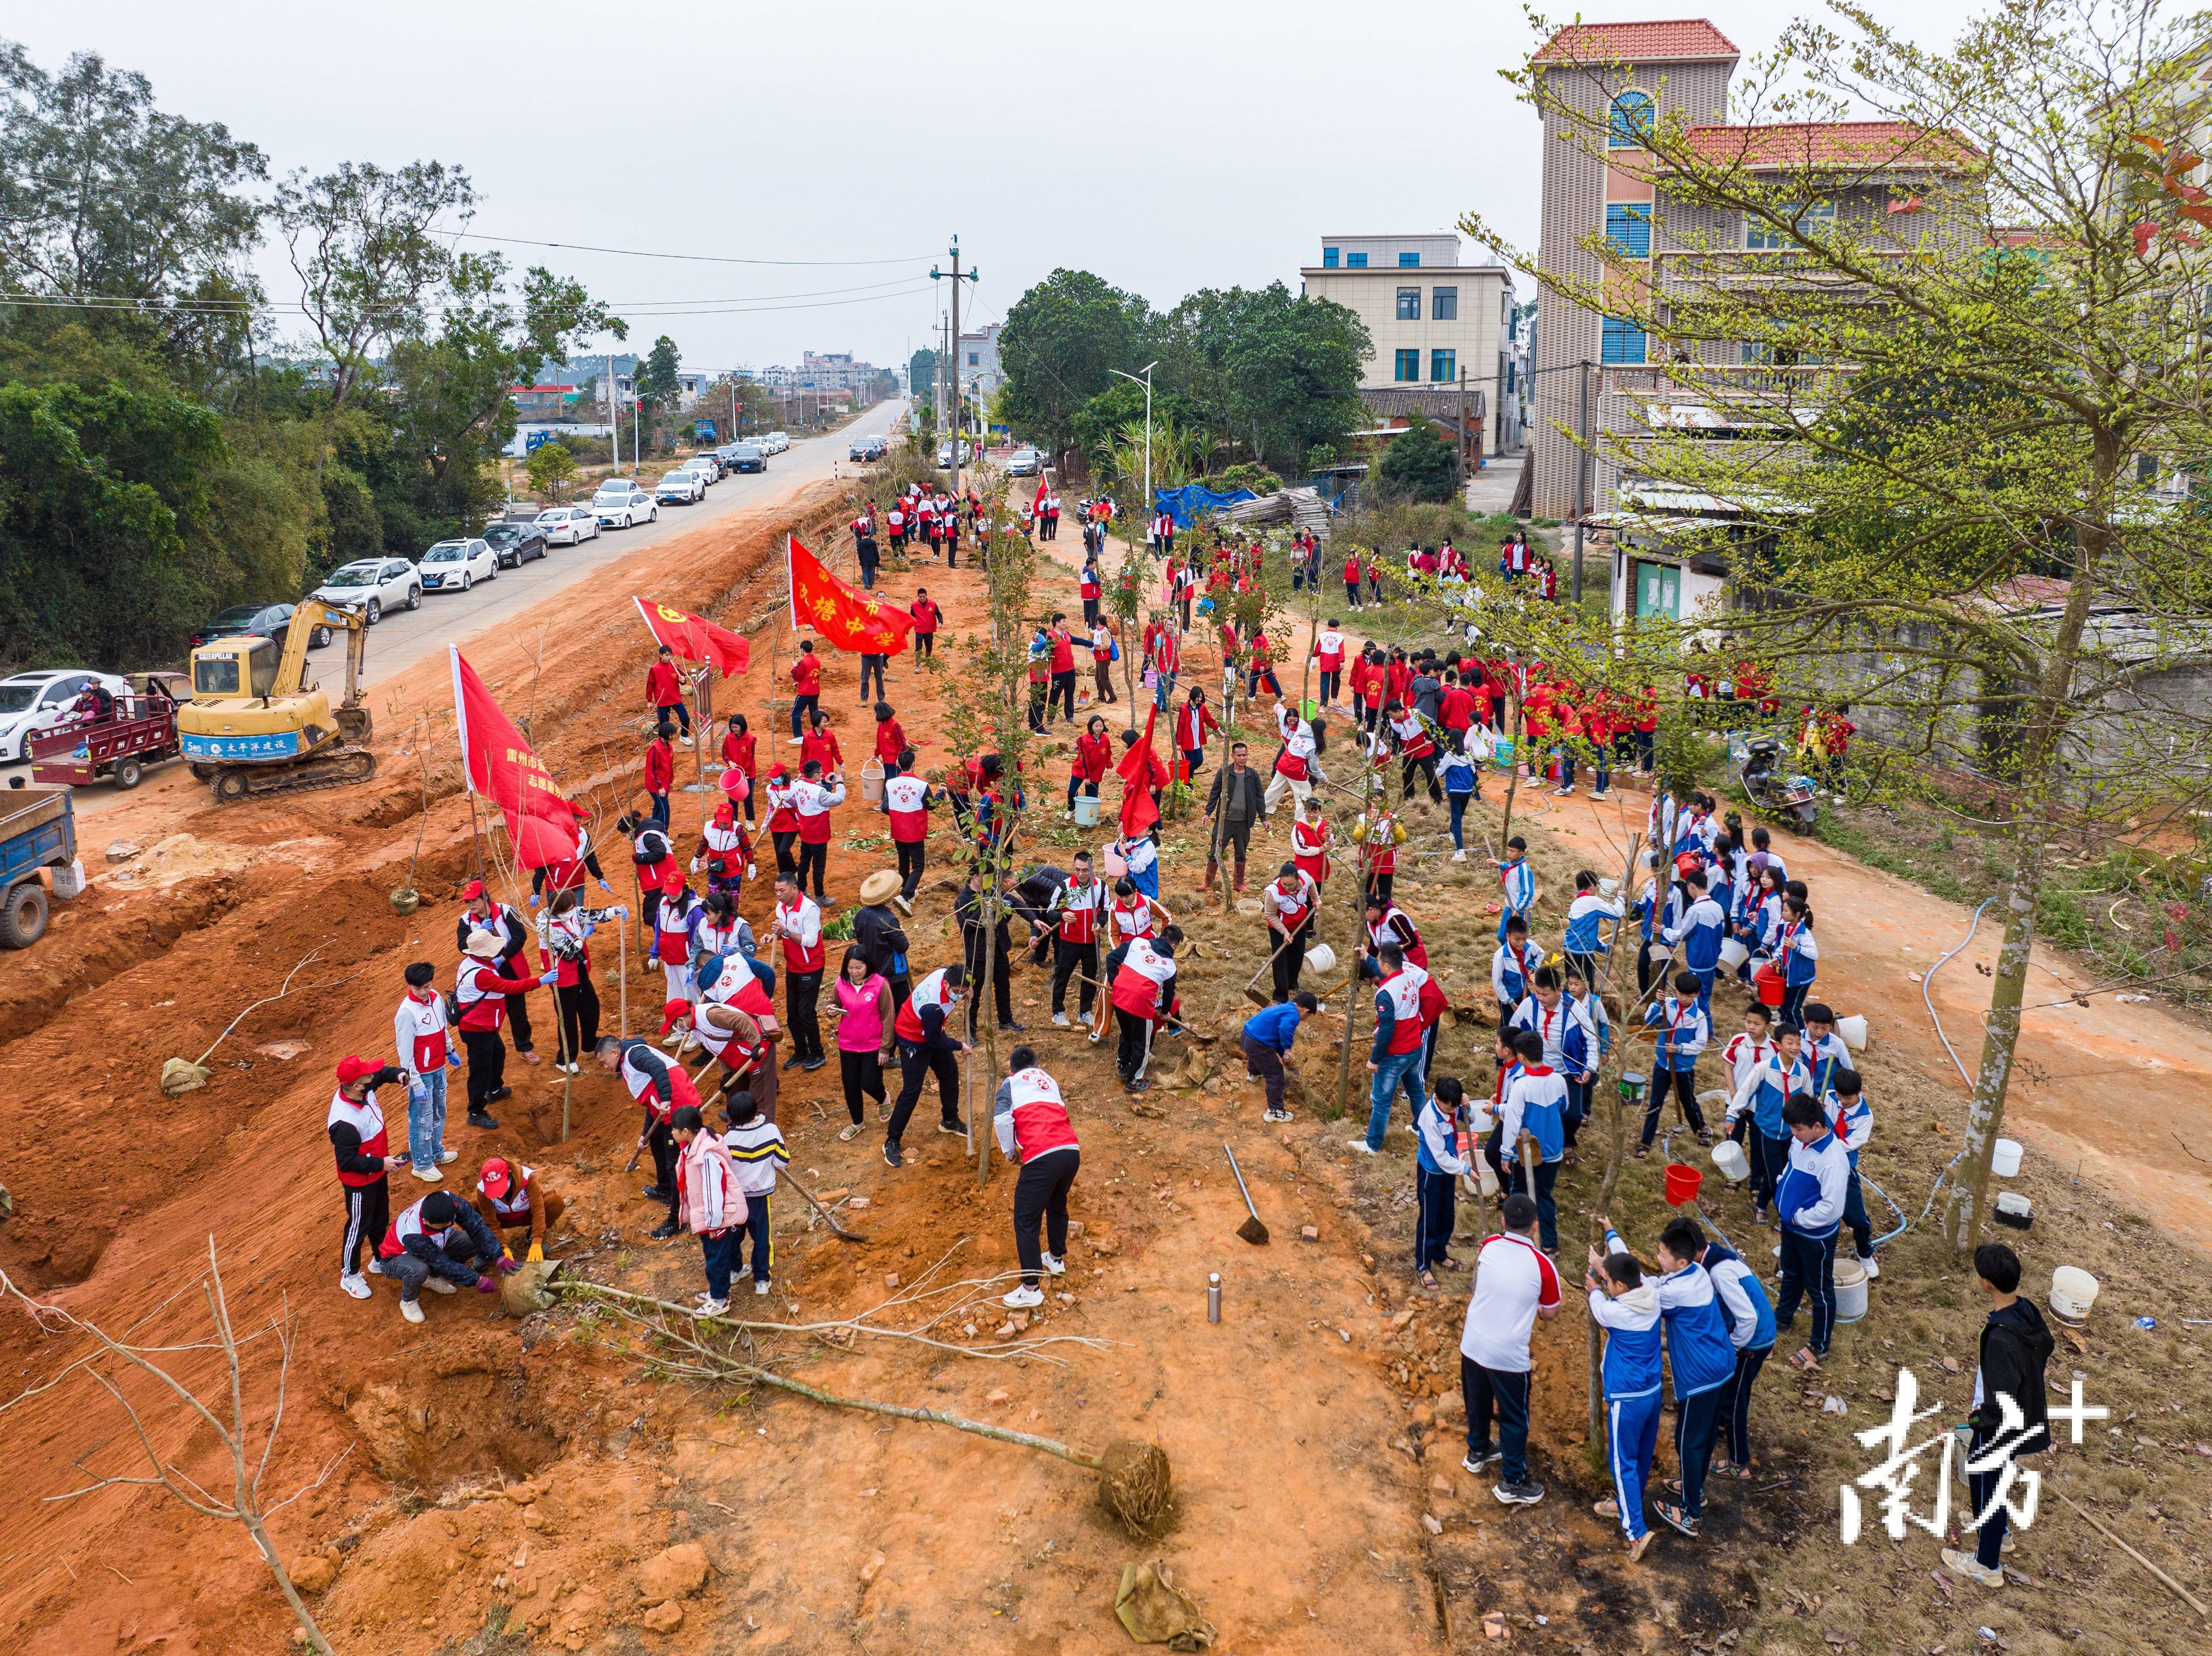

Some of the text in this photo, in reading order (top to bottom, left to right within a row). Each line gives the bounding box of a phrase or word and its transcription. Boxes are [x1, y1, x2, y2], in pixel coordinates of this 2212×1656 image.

[228, 740, 287, 753] 太平洋建设
